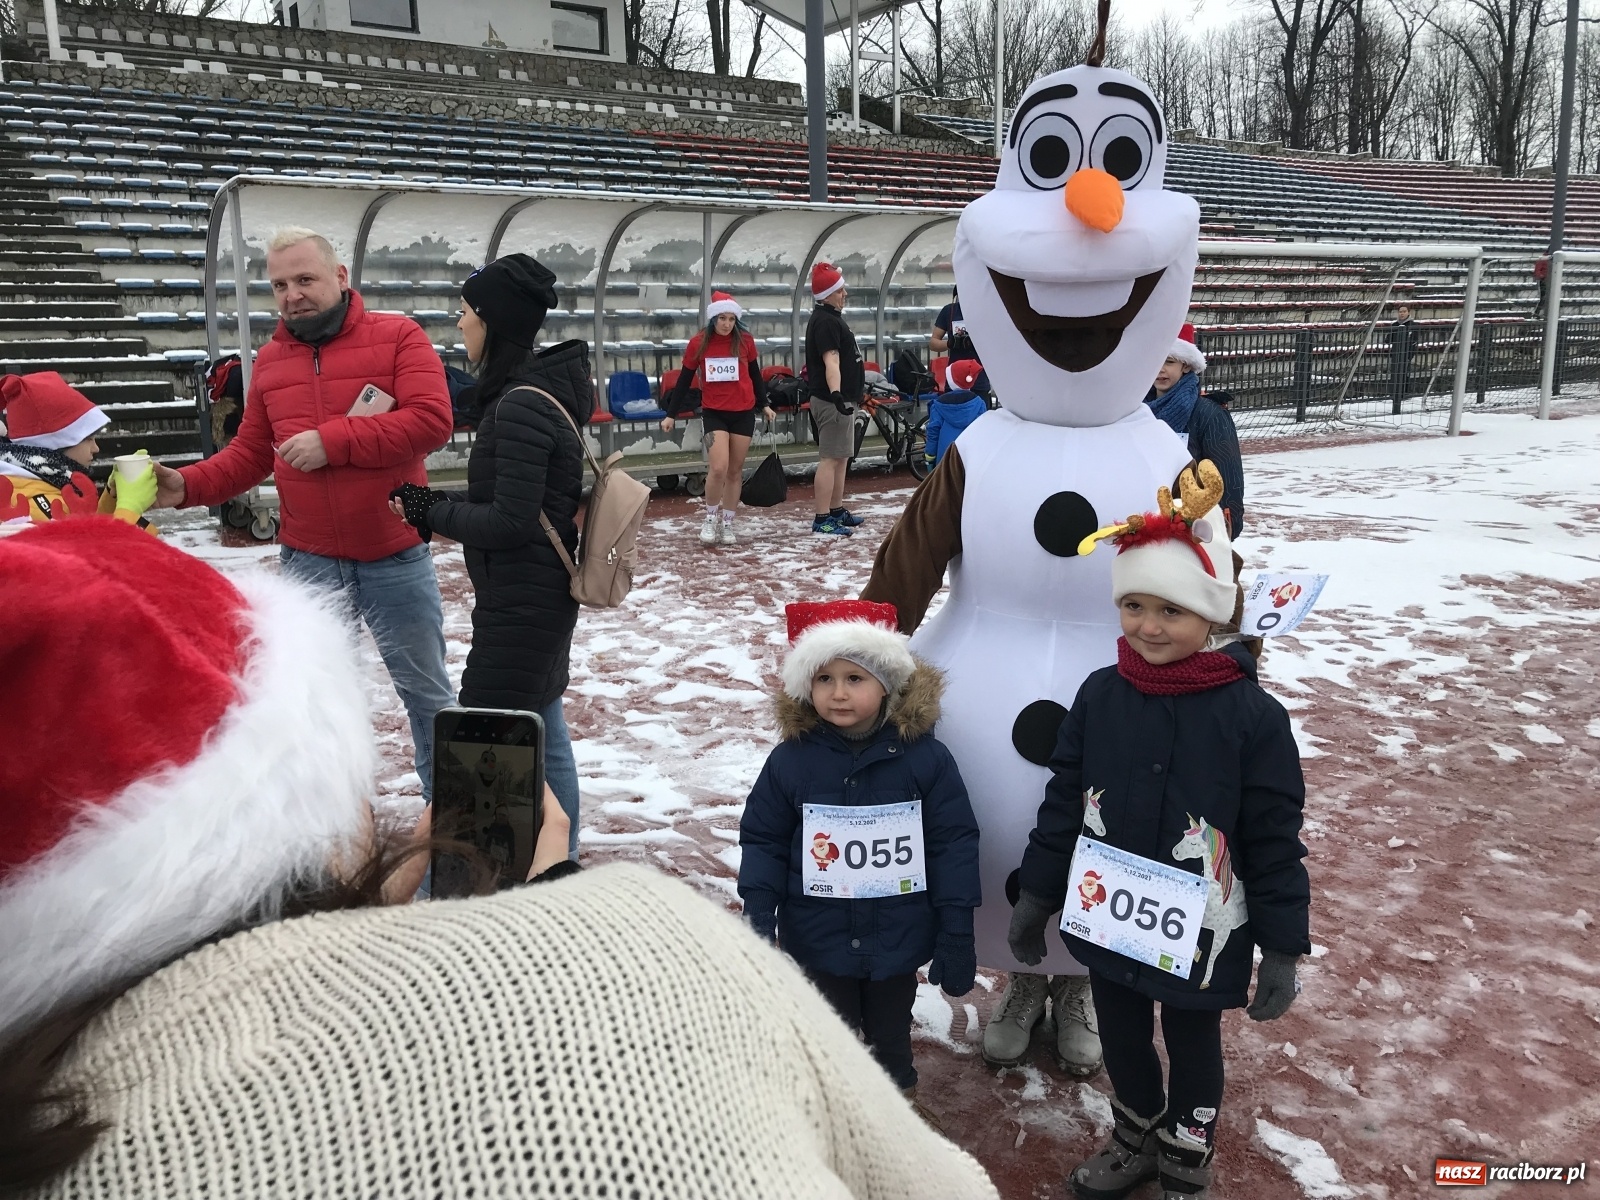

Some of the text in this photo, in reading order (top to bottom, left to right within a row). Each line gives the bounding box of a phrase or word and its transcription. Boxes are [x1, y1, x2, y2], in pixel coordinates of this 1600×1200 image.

[717, 366, 735, 374] 049
[844, 835, 913, 869] 055
[1123, 867, 1152, 881] 5.12.2021
[1110, 889, 1187, 940] 056
